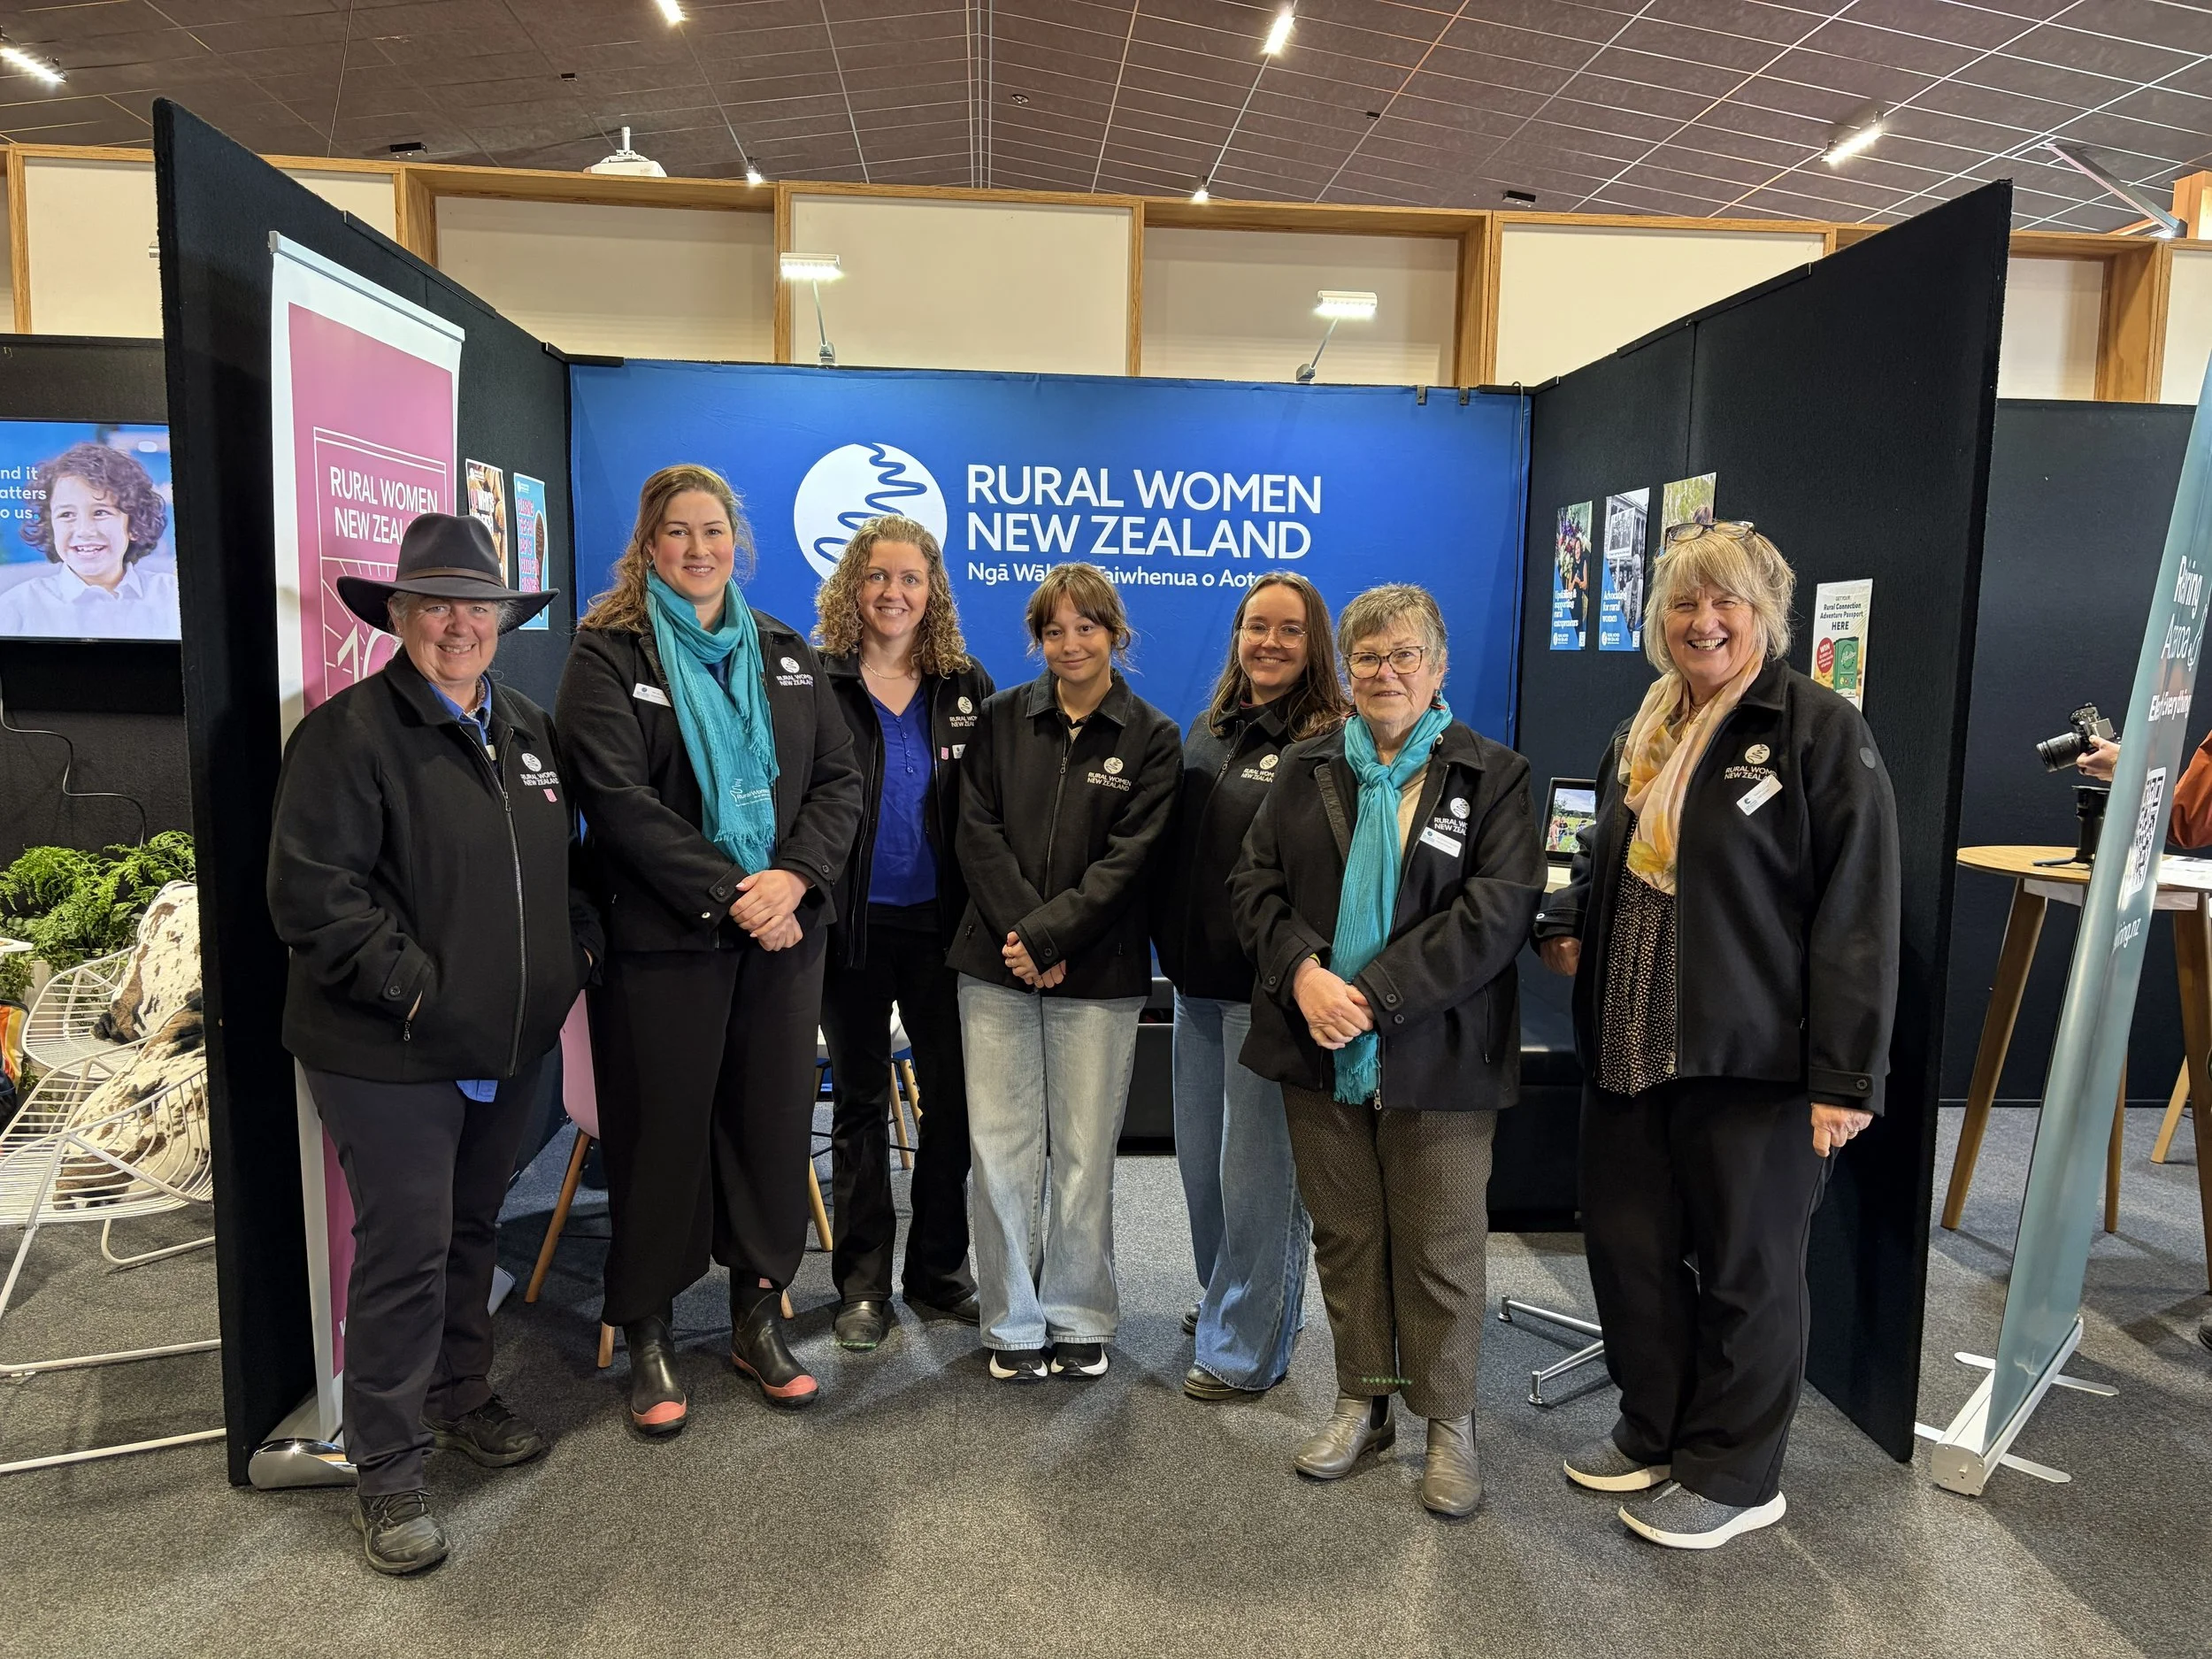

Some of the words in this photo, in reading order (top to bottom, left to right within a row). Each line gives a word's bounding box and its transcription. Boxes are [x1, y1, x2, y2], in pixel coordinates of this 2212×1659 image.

[0, 466, 21, 480] nd
[27, 466, 38, 480] it
[0, 487, 47, 500] atters
[330, 466, 378, 505] RURAL
[380, 478, 438, 514] WOMEN
[967, 464, 1125, 508] RURAL
[1133, 469, 1322, 514] WOMEN
[0, 509, 10, 518] o
[334, 507, 370, 541] NEW
[373, 513, 405, 545] ZEAL
[968, 512, 1081, 553] NEW
[1090, 515, 1311, 559] ZEALAND
[968, 562, 1010, 586] Ngā
[1202, 574, 1215, 587] o
[1836, 602, 1862, 611] Connection
[1832, 621, 1849, 631] HERE
[1087, 772, 1107, 780] RURAL
[1252, 774, 1273, 783] ZEALAN
[1724, 772, 1742, 780] NEW
[1433, 817, 1458, 826] RURAL
[1434, 823, 1453, 832] NEW
[1453, 826, 1467, 836] ZEAL
